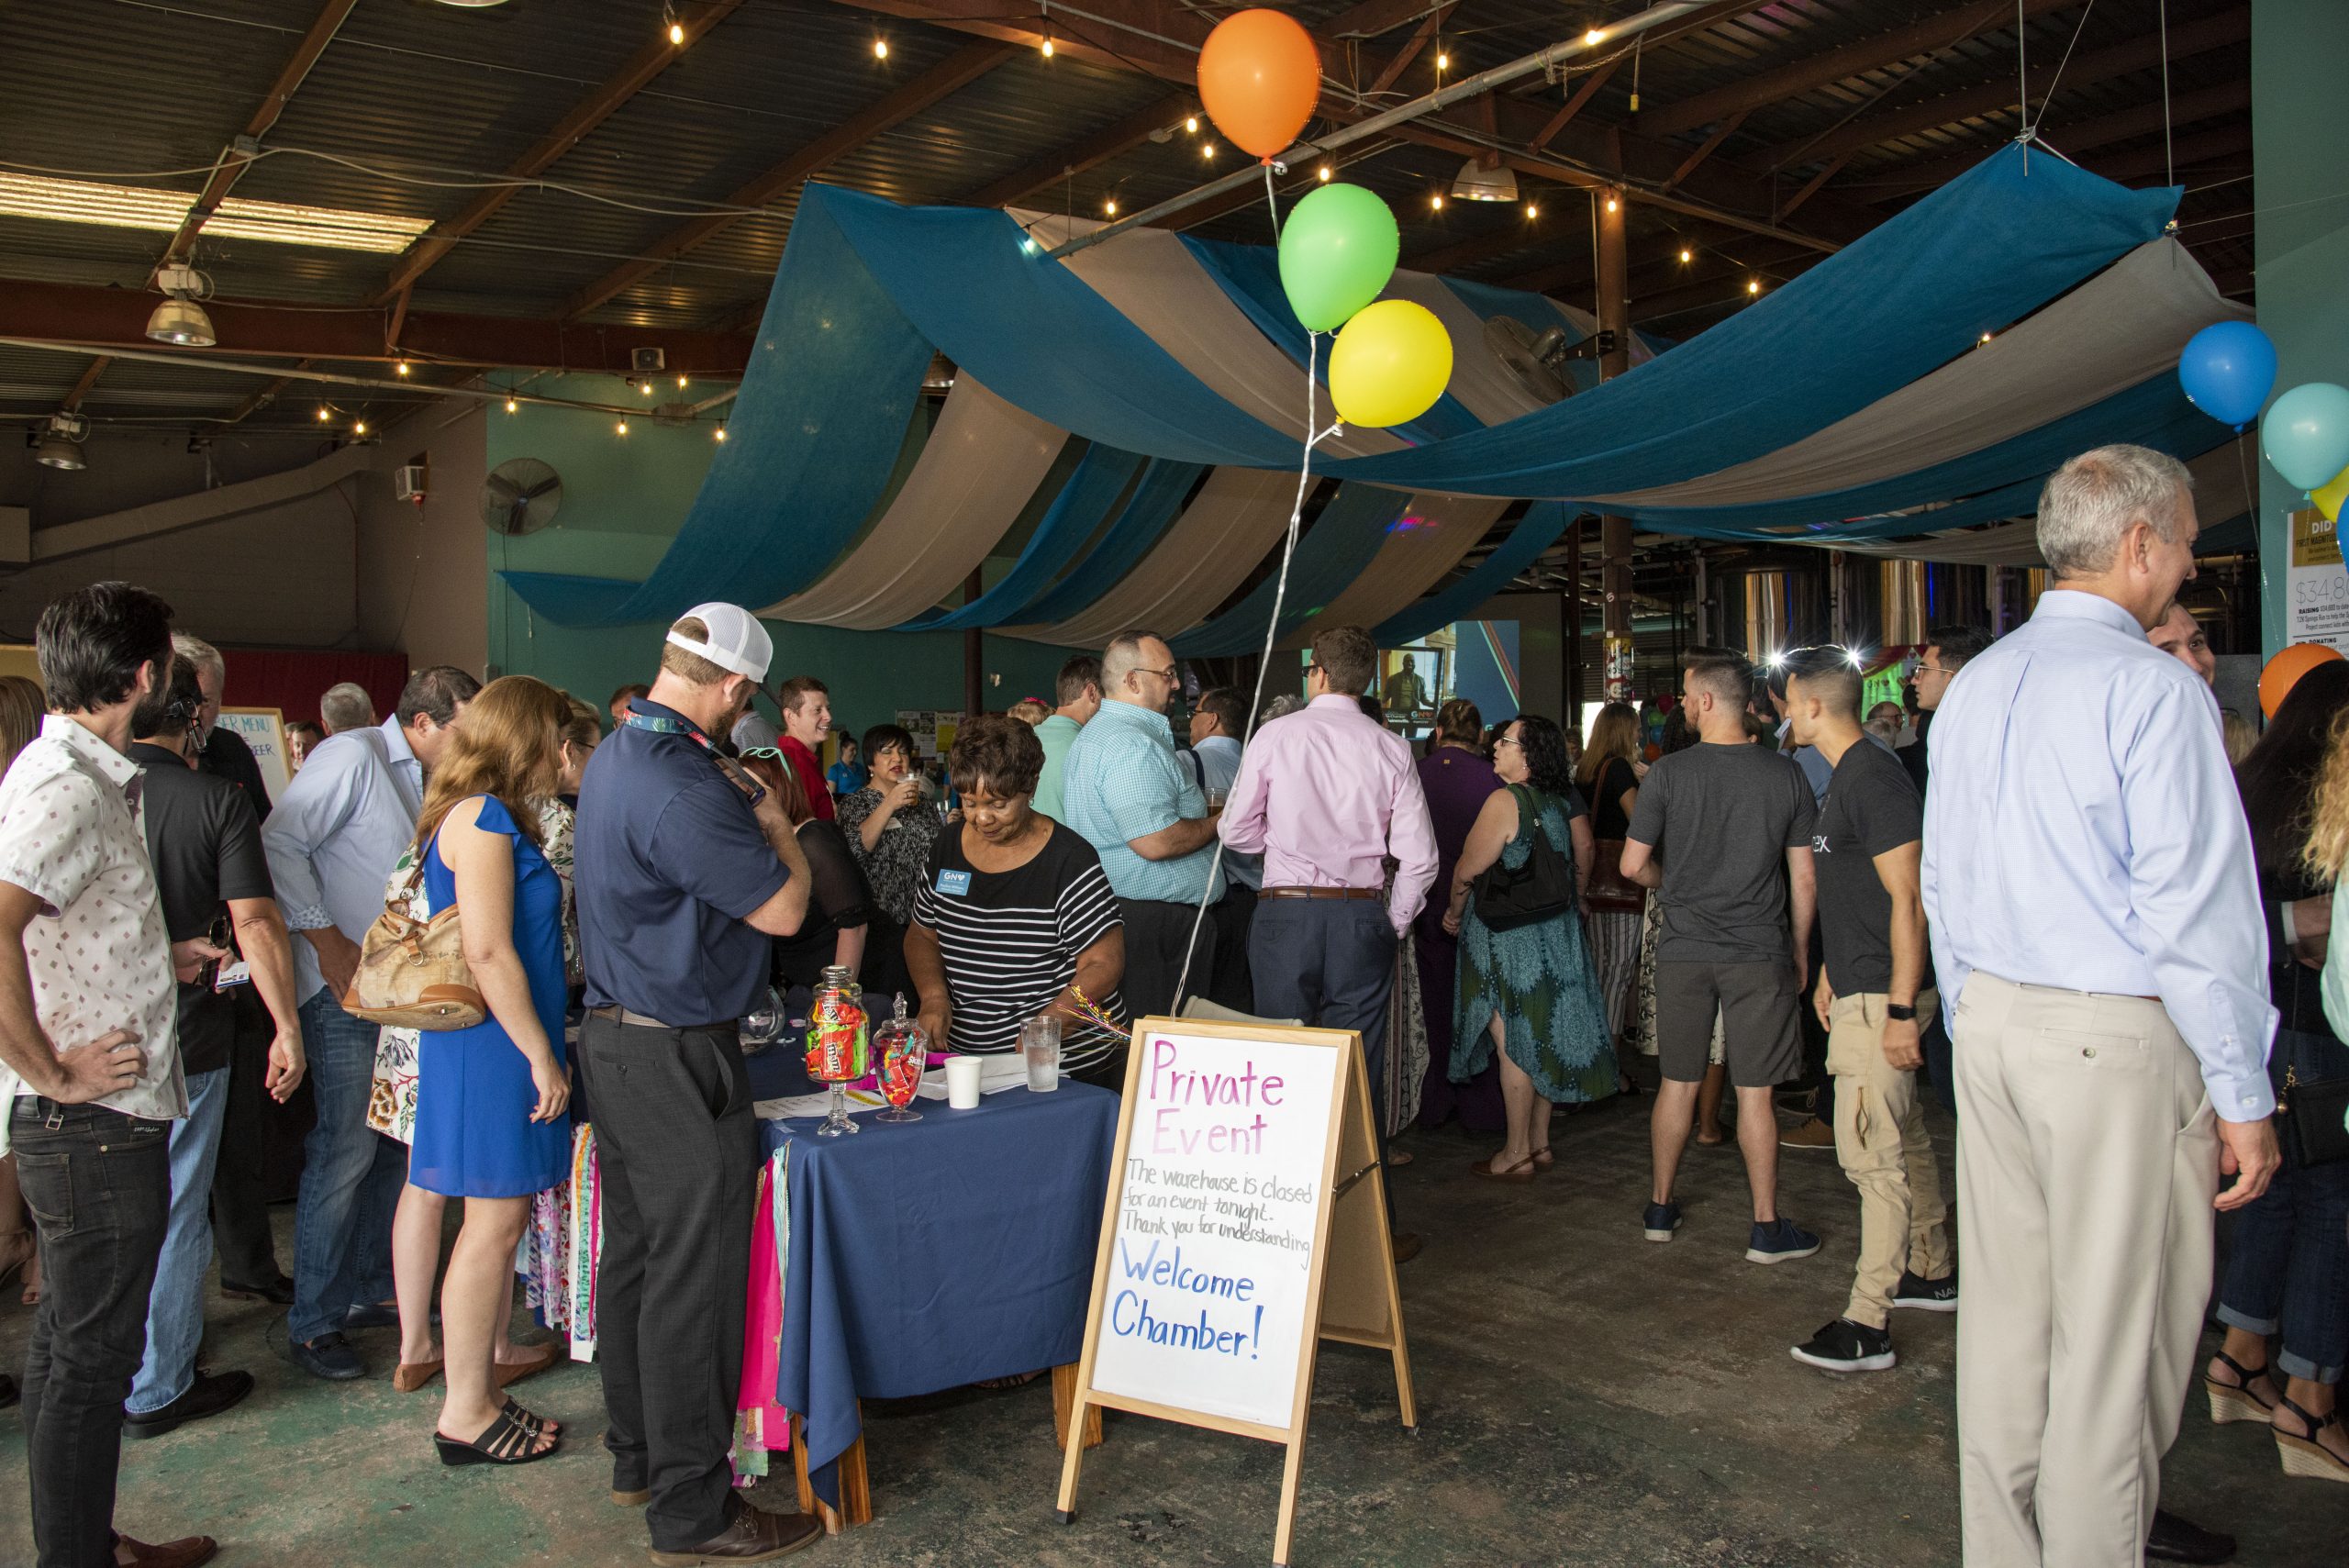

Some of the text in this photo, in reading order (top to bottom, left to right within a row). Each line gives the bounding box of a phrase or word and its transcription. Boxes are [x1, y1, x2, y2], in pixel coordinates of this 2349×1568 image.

[2311, 519, 2332, 534] DID
[241, 717, 271, 733] MENU
[1150, 1040, 1285, 1107] Private
[1152, 1108, 1268, 1155] Event
[1129, 1158, 1313, 1205] The warehouse is closed
[1124, 1186, 1274, 1230] for an event tonight.
[1124, 1209, 1311, 1271] Thank you for understanding
[1119, 1237, 1255, 1302] Welcome
[1113, 1289, 1264, 1361] Chamber!
